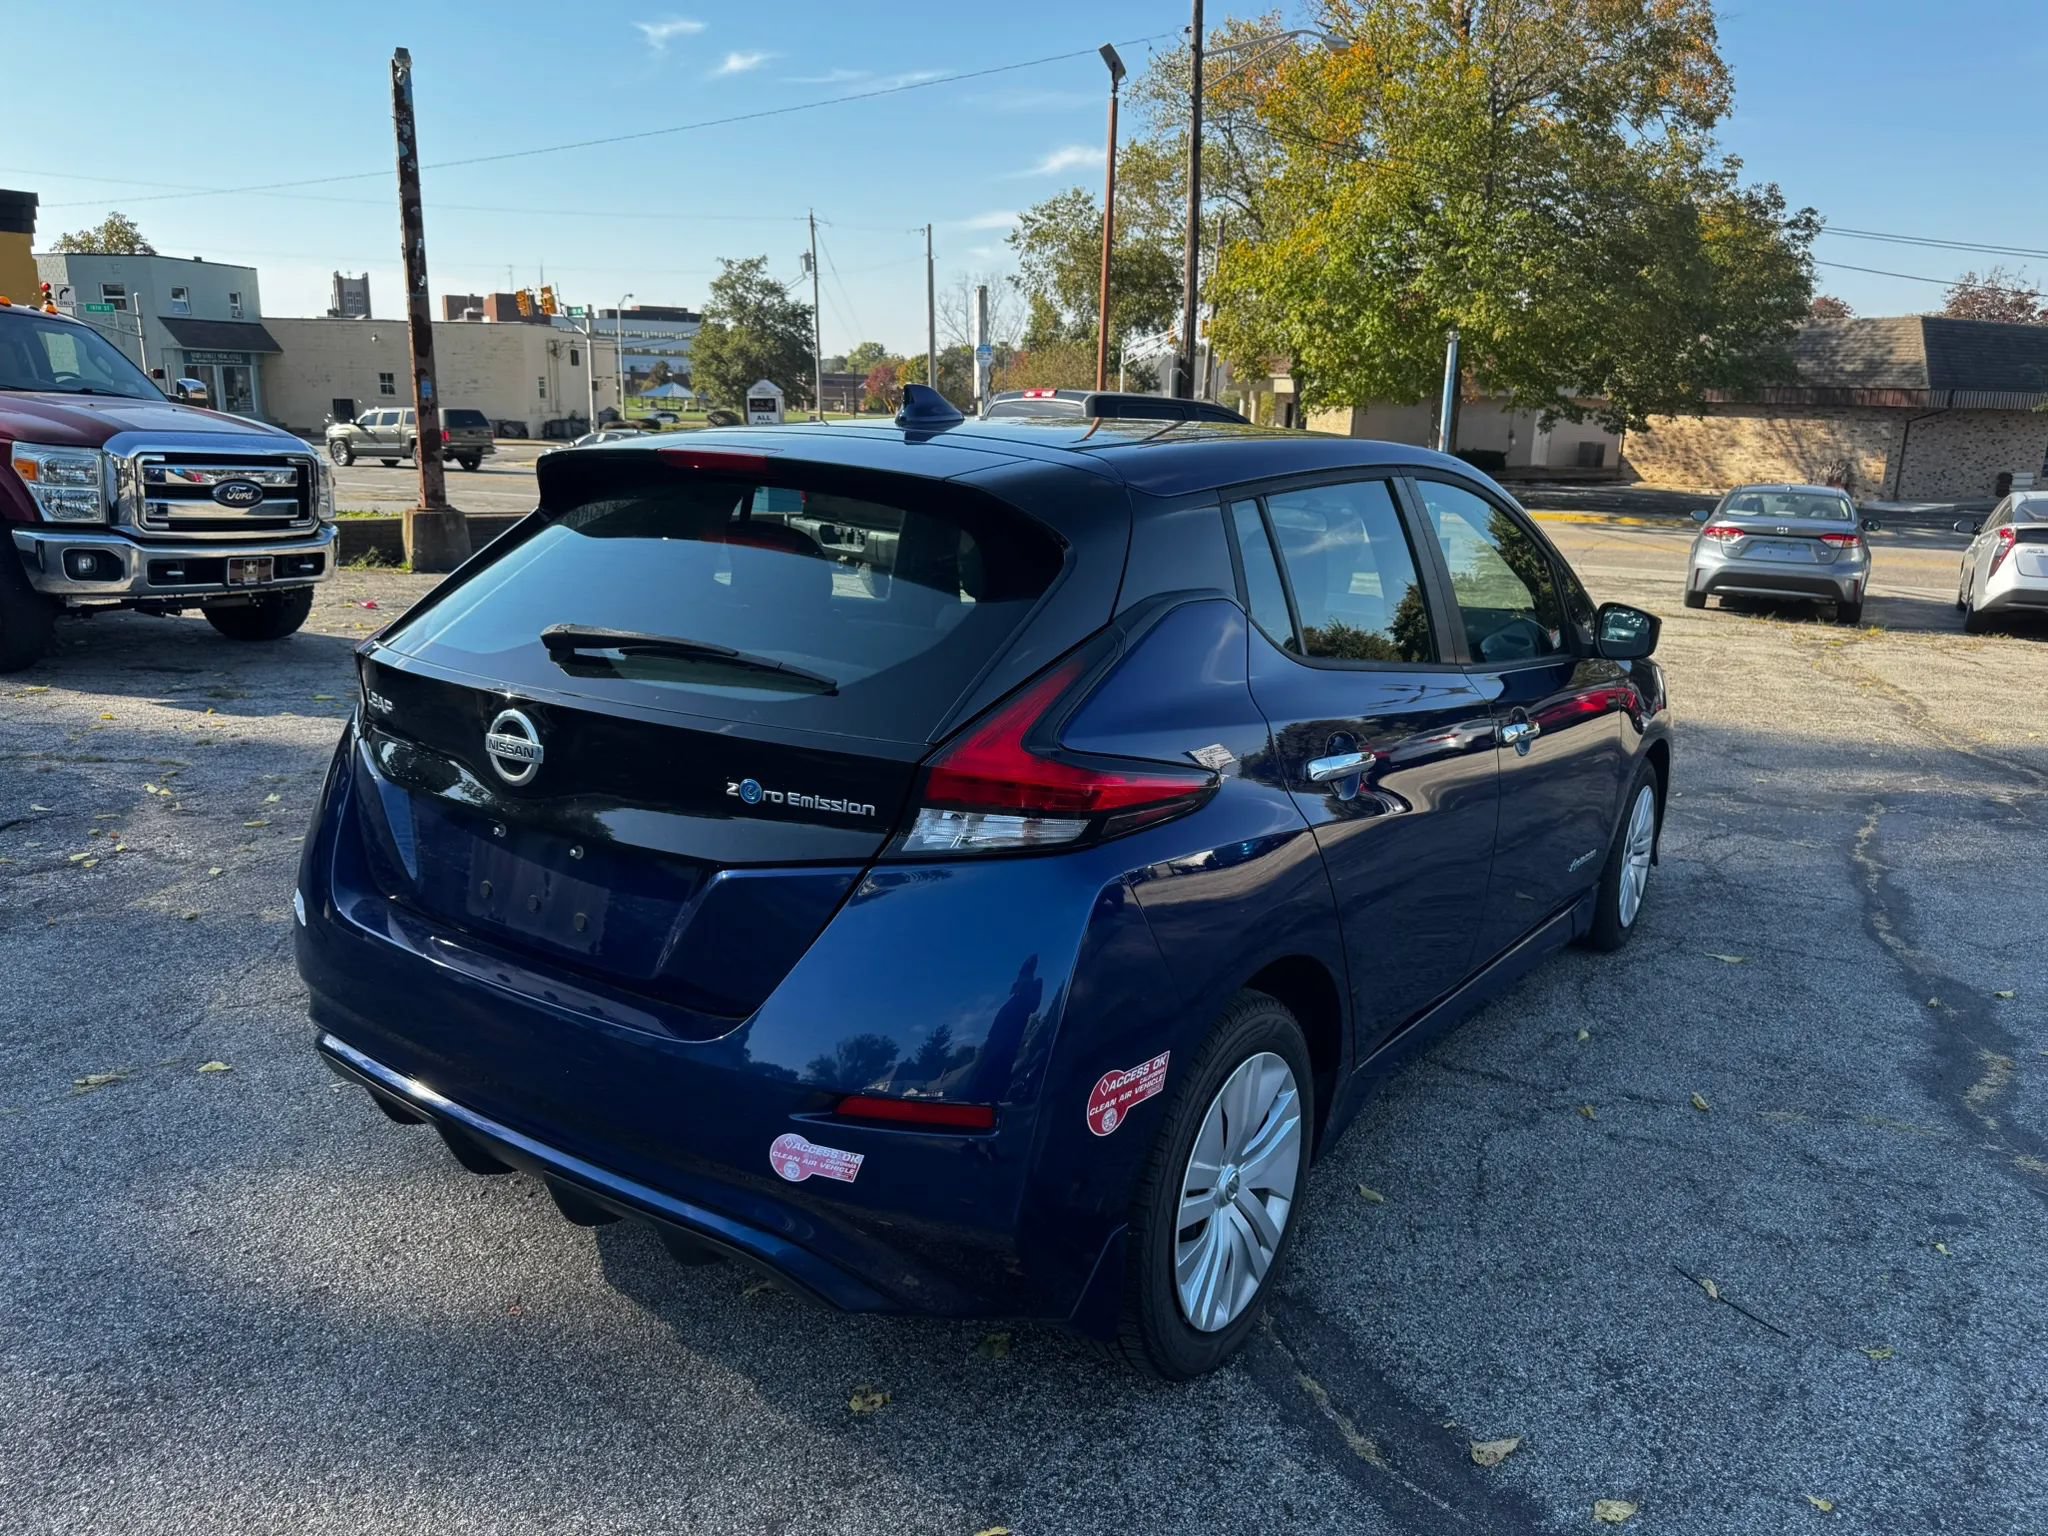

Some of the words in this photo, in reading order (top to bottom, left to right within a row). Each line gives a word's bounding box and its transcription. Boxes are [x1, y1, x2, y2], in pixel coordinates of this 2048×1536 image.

[226, 485, 254, 500] Ford
[488, 739, 534, 759] NISSAN
[787, 791, 876, 817] Emission
[1108, 1063, 1150, 1092] ACCESS
[1152, 1054, 1168, 1070] OK
[1139, 1067, 1165, 1085] CALIFORNIA
[1089, 1097, 1117, 1116] CLEAN
[1118, 1090, 1133, 1103] AIR
[1134, 1074, 1164, 1095] VEHICLE
[772, 1151, 801, 1162] CLEAN
[802, 1159, 818, 1167] AIR
[820, 1162, 856, 1175] VEHICLE
[792, 1143, 839, 1159] ACCESS
[842, 1153, 863, 1164] OK
